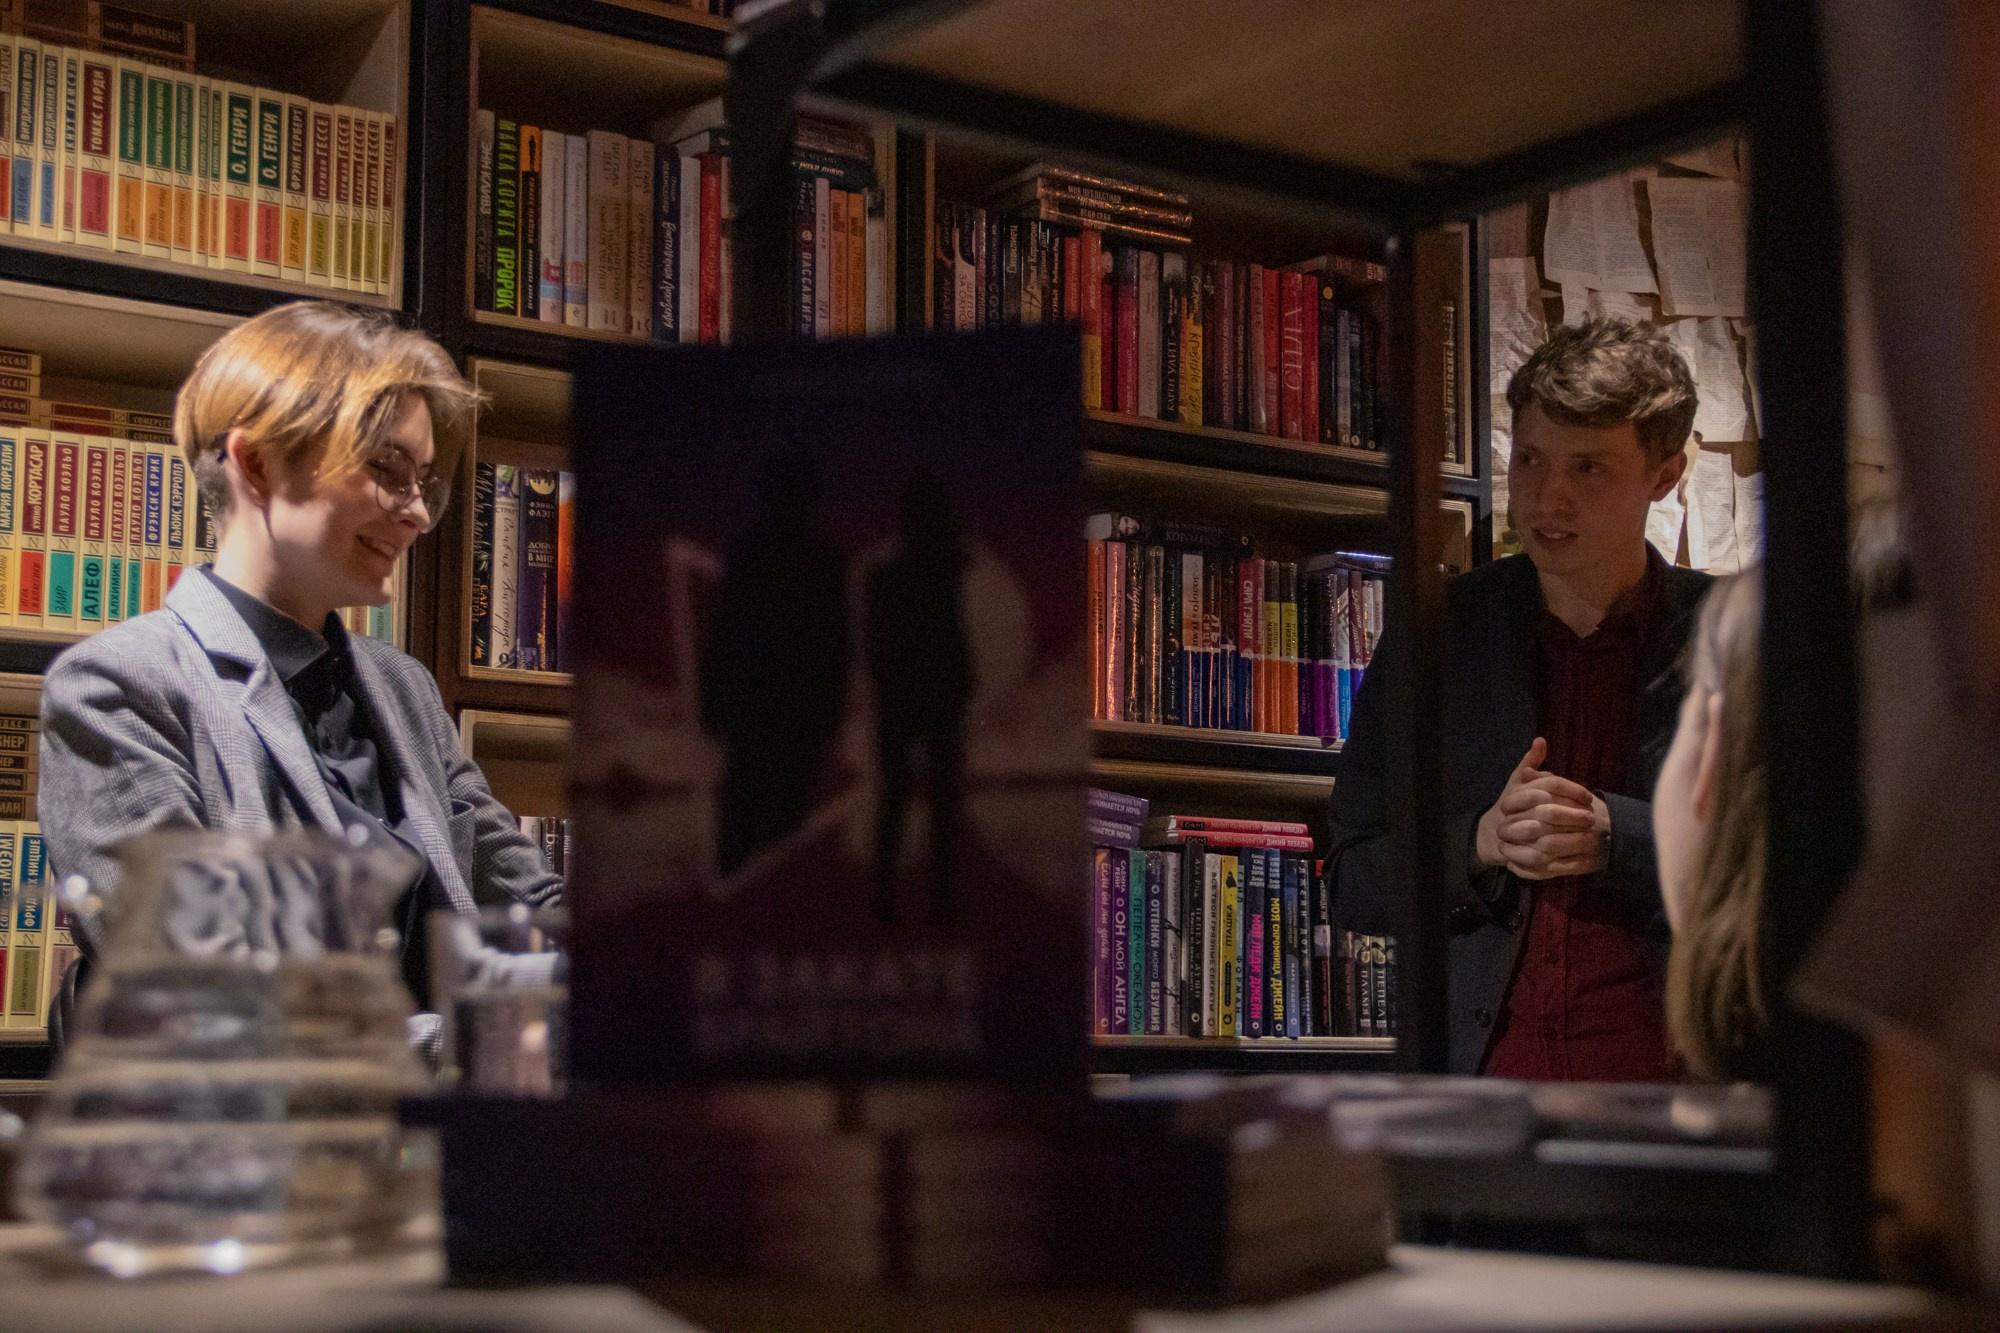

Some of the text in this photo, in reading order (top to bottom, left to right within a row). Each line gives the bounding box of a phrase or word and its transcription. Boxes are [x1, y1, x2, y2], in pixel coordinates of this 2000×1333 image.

[19, 53, 34, 141] ВИРДЖИНИЯ ВУЛФ
[44, 60, 57, 146] ВИРДЖИНИЯ ВУЛФ
[92, 70, 105, 109] ГАРДИ
[65, 117, 75, 149] КНУТ
[91, 112, 104, 152] ТОМАС
[231, 107, 247, 174] О. ГЕНРИ
[261, 112, 278, 179] О. ГЕНРИ
[291, 108, 302, 190] ФРЭНК ГЕРБЕРТ
[316, 118, 328, 196] ГЕРМАН ГЕССЕ
[338, 122, 349, 199] ГЕРМАН ГЕССЕ
[354, 125, 364, 162] ГЕССЕ
[383, 138, 393, 166] ГЕССЕ
[368, 126, 379, 205] ГЕРМАН ГЕССЕ
[480, 140, 492, 215] ЭНН КЛИВЗ
[497, 178, 517, 237] КОРИТА
[291, 243, 299, 263] ДЕТИ
[495, 246, 516, 310] ПРОРОК
[959, 273, 966, 288] ЗА
[801, 252, 812, 334] ПАССАЖИРЫ
[967, 282, 975, 326] ШЕПОТ
[0, 355, 27, 367] ССАН
[1167, 338, 1177, 412] КАРЕН УАЙТ
[1283, 307, 1302, 390] СИЛА
[2, 444, 13, 529] МАРИЯ КОРЕЛЛИ
[28, 445, 44, 530] ХУЛИО КОРТАСАР
[60, 447, 72, 532] ПАУЛО КОЭЛЬО
[90, 452, 102, 536] ПАУЛО КОЭЛЬО
[113, 453, 124, 538] ПАУЛО КОЭЛЬО
[131, 457, 142, 541] ПАУЛО КОЭЛЬО
[148, 457, 159, 541] ФРЭНСИС КРИК
[170, 462, 183, 544] ЛЬЮИС КЭРРОЛЛ
[21, 589, 29, 607] ИГРА
[56, 585, 67, 612] ЗАИР
[83, 562, 99, 616] АЛЕФ
[110, 562, 121, 616] АЛХИМИК
[479, 584, 488, 618] САРА
[1243, 580, 1253, 640] САРА ГЭЙЛИ
[376, 611, 384, 639] ПРИЗРАК
[1266, 838, 1308, 848] ДИКИЙ ЛЕБЕДЬ
[1282, 825, 1304, 834] ЛЕБЕДЬ
[0, 836, 14, 928] СОМСЕТ МОЭМ
[25, 838, 41, 927] ФРИДХ НИЦШЕ
[1100, 862, 1111, 888] Если
[1133, 897, 1143, 942] ПЕПЕЛ
[1151, 898, 1160, 948] ОТТЕНКИ
[1225, 904, 1233, 947] ПТАШКА
[1271, 897, 1281, 922] МОЯ
[1299, 867, 1308, 954] ДЖЕЙН ДОУ
[1097, 927, 1109, 959] знали
[1115, 911, 1127, 1025] ОН МОЙ АНГЕЛ
[1249, 913, 1262, 1019] МОЯ ЛЕДИ ДЖЕЙН
[1272, 923, 1281, 975] СКРОМНИЦА
[1133, 962, 1143, 1032] ОКЕАНОМ
[1151, 981, 1160, 1032] БЕЗУМИЯ
[1234, 955, 1242, 1015] ФОРМАН
[1271, 977, 1283, 1021] ДЖЕЙН
[1360, 970, 1369, 1017] ПЛАМЯ
[1376, 969, 1386, 1017] ПЕПЕЛ
